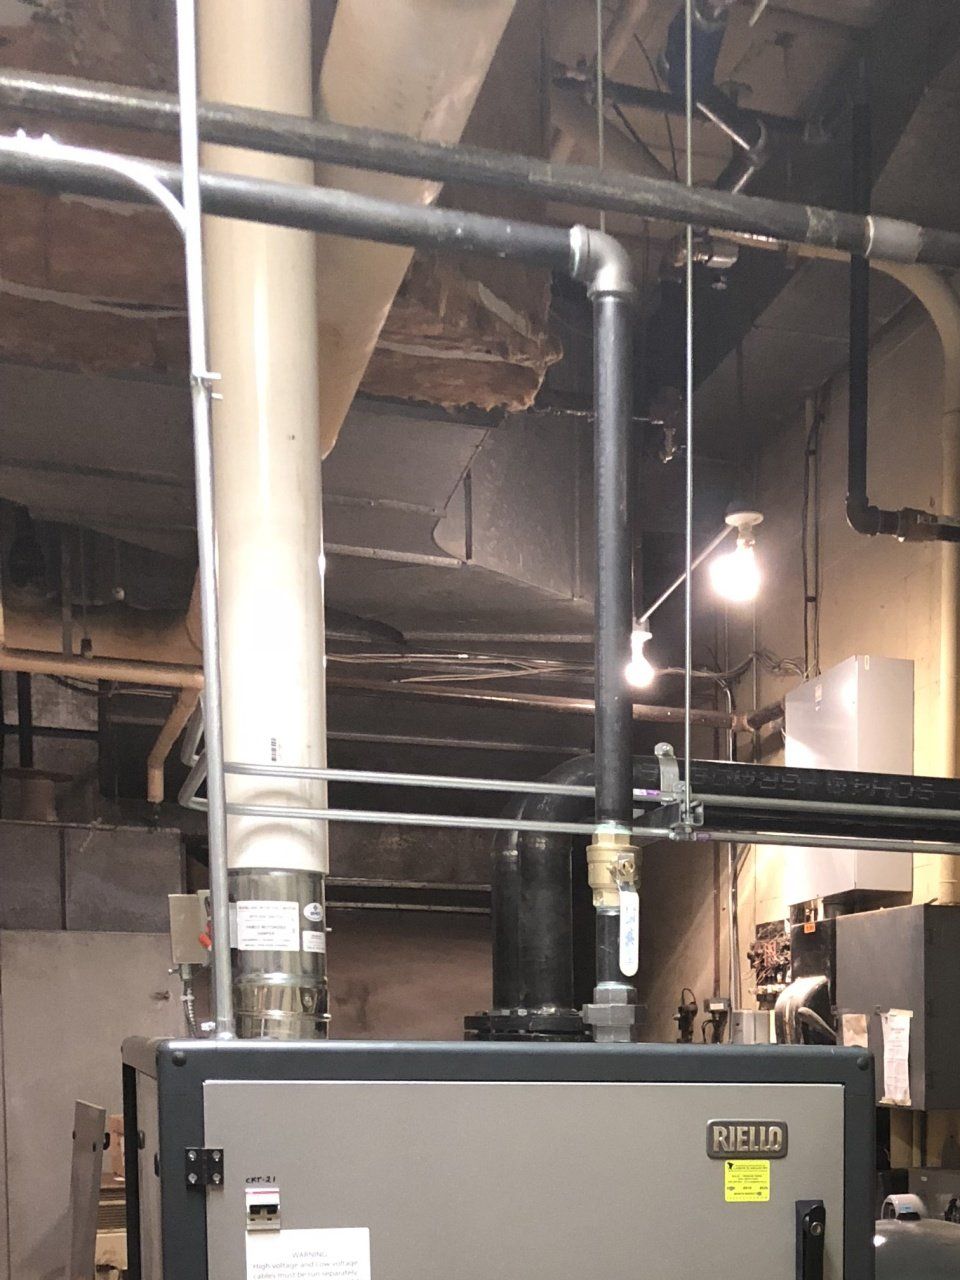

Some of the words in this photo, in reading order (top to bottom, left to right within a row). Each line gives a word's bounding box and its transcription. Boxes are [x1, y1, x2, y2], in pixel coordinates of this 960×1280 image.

[713, 1125, 783, 1152] RIELLO
[252, 1262, 271, 1270] High
[277, 1271, 296, 1279] must
